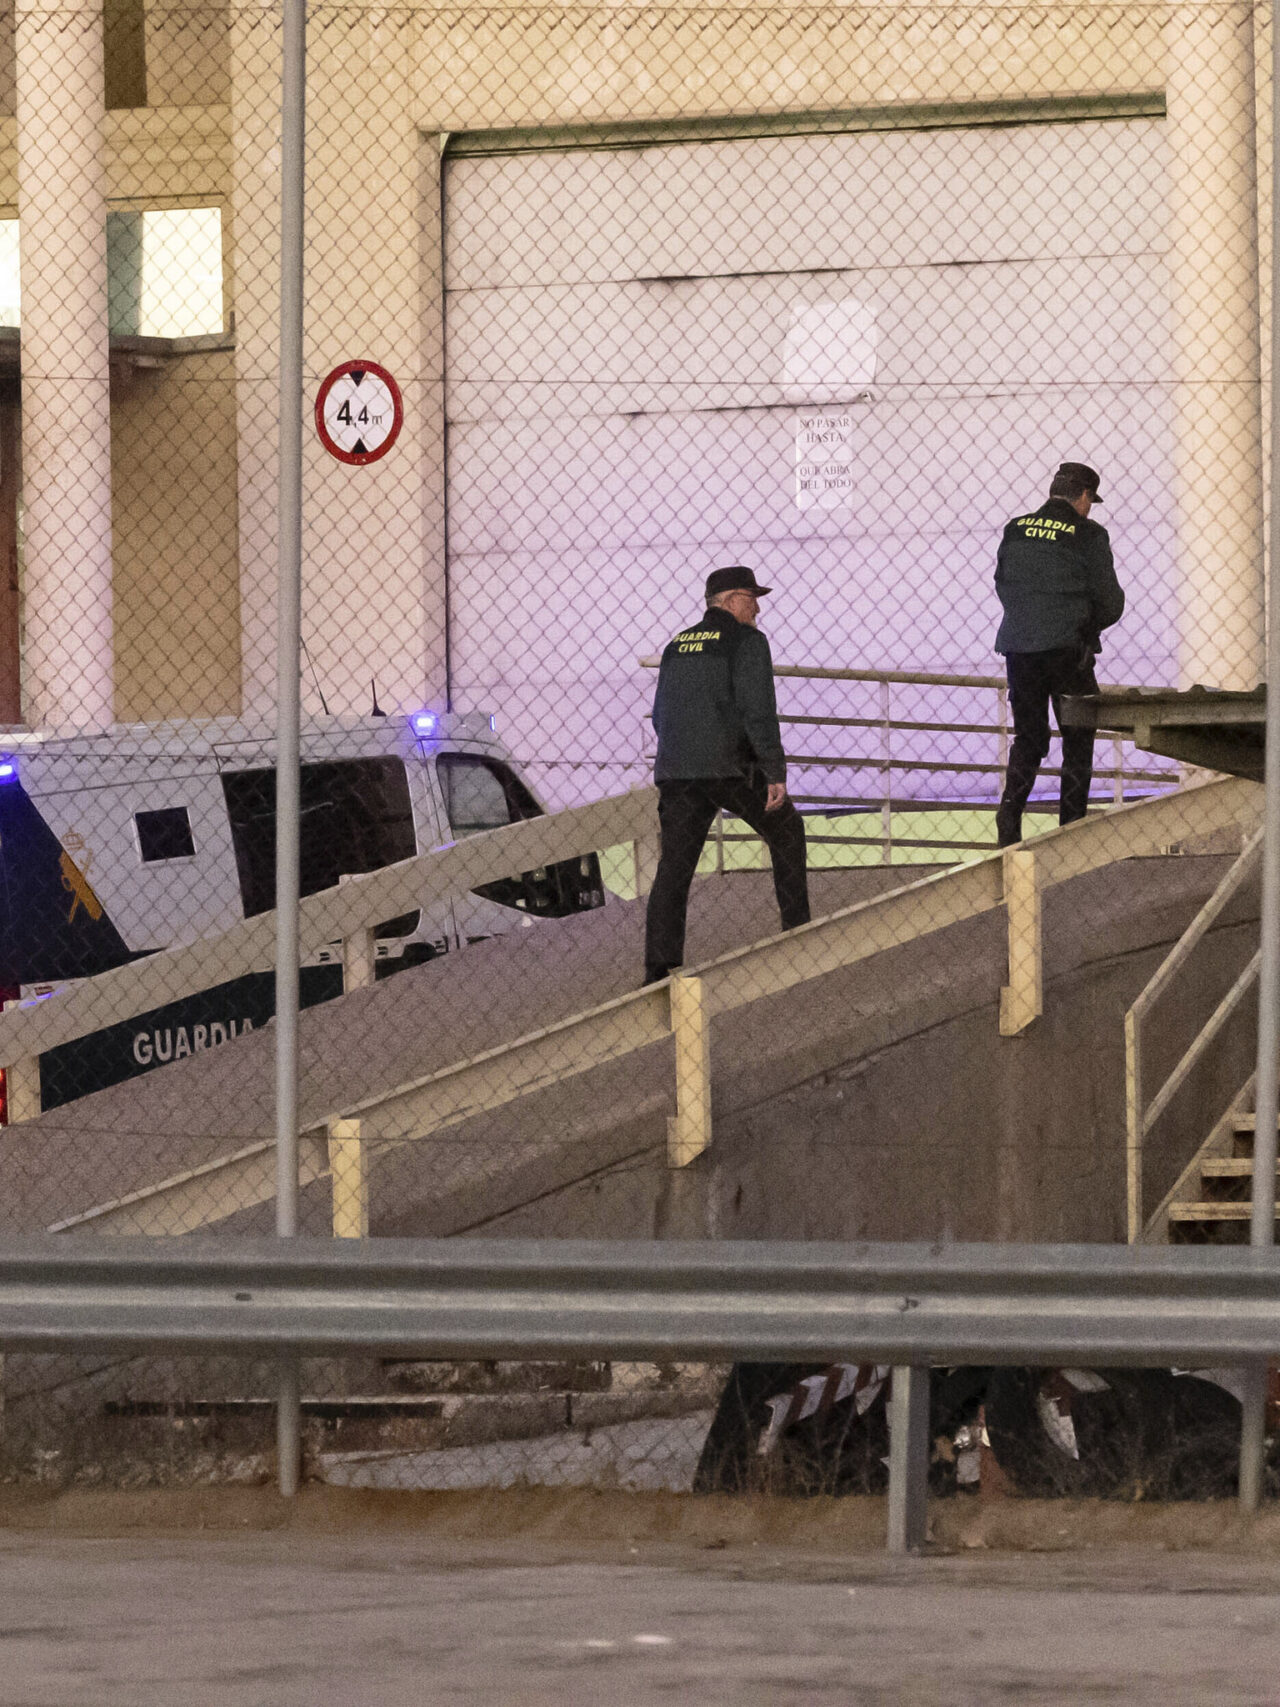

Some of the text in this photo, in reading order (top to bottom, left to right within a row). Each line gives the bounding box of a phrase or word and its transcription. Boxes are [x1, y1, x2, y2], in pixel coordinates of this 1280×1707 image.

[800, 417, 850, 428] NO PASAR
[806, 432, 843, 443] HASTA
[824, 466, 850, 475] ABRA
[824, 479, 852, 489] TODO
[1017, 517, 1075, 535] GUARDIA
[1025, 527, 1056, 541] CIVIL
